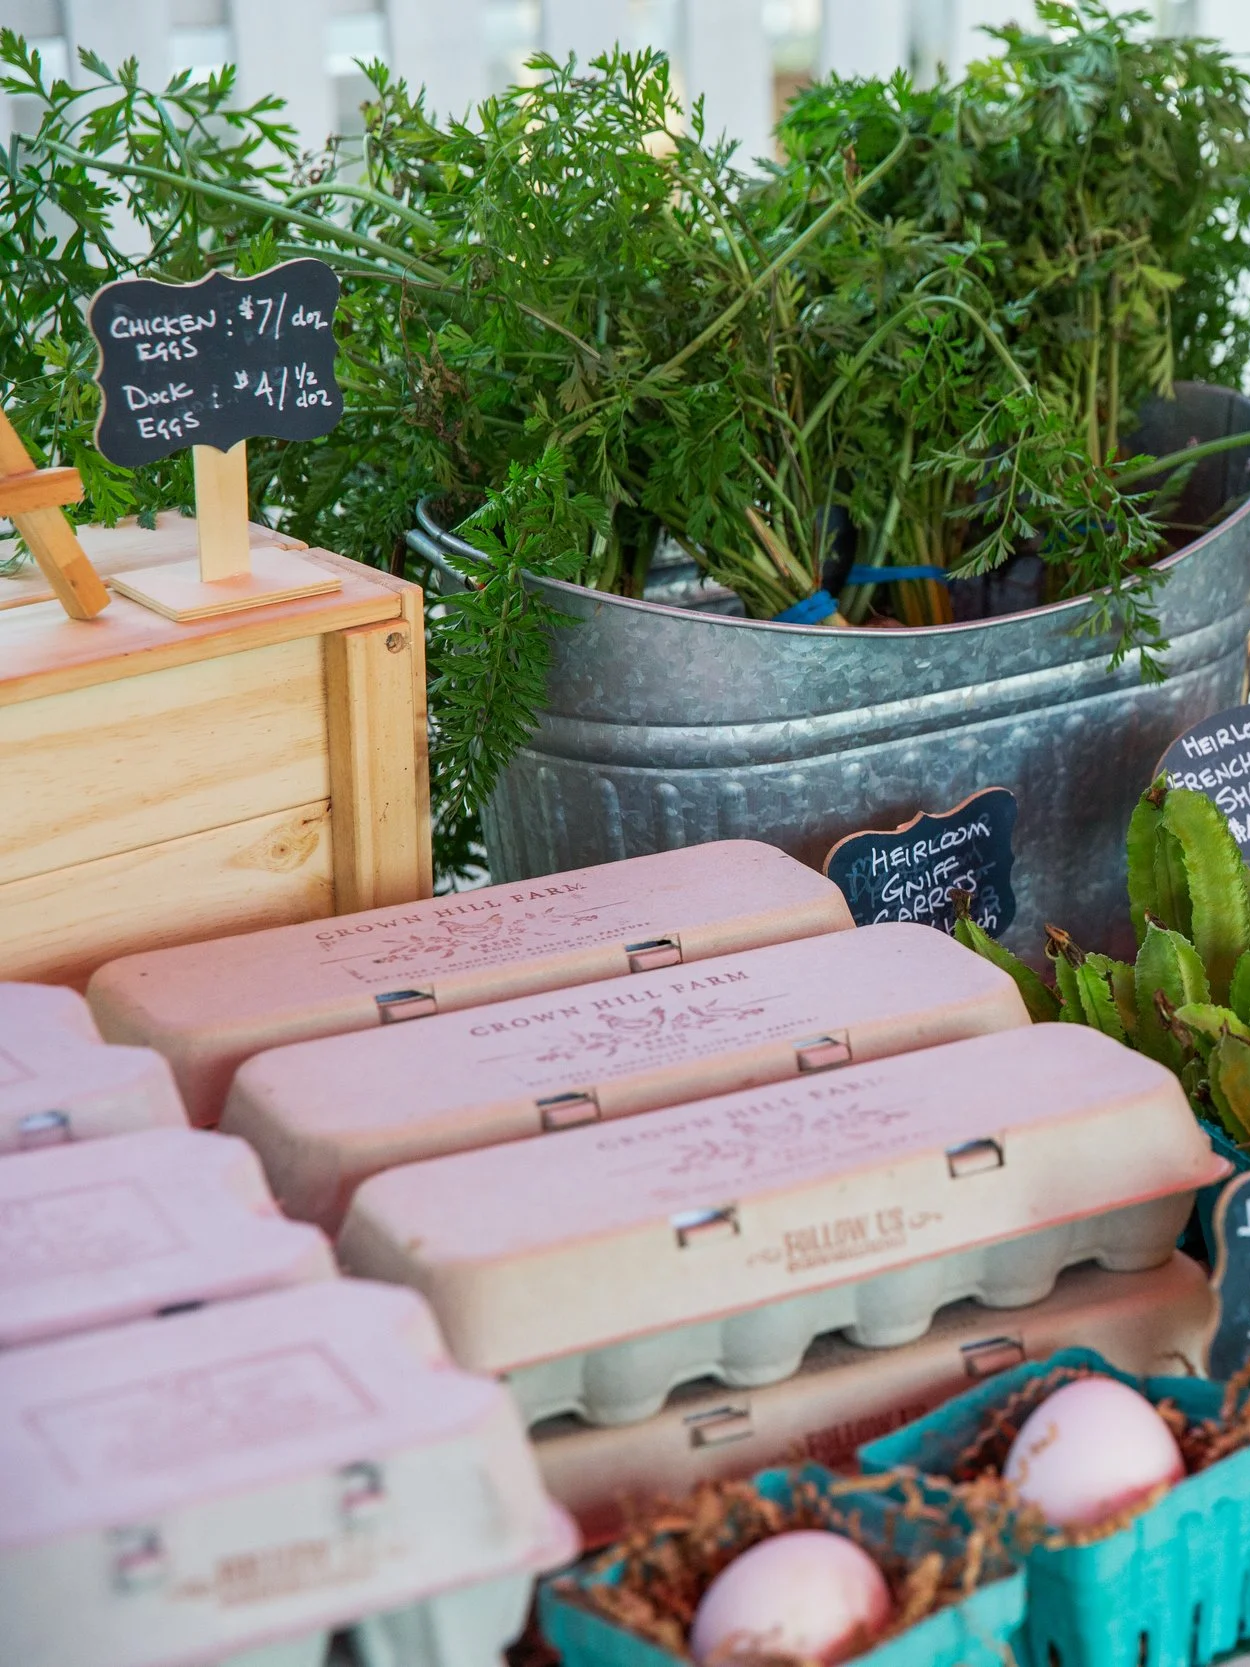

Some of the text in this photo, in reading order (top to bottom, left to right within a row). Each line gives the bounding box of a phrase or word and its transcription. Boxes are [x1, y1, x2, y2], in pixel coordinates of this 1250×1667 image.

[109, 309, 216, 339] CHICKEN
[136, 336, 199, 361] EGGS
[295, 389, 333, 408] doz
[137, 411, 200, 440] EGGS
[871, 821, 990, 877] HEIRLOOM
[881, 855, 960, 905] GNIFF
[314, 881, 587, 942] CROWN HILL FARM
[469, 969, 751, 1038] CROWN HILL FARM
